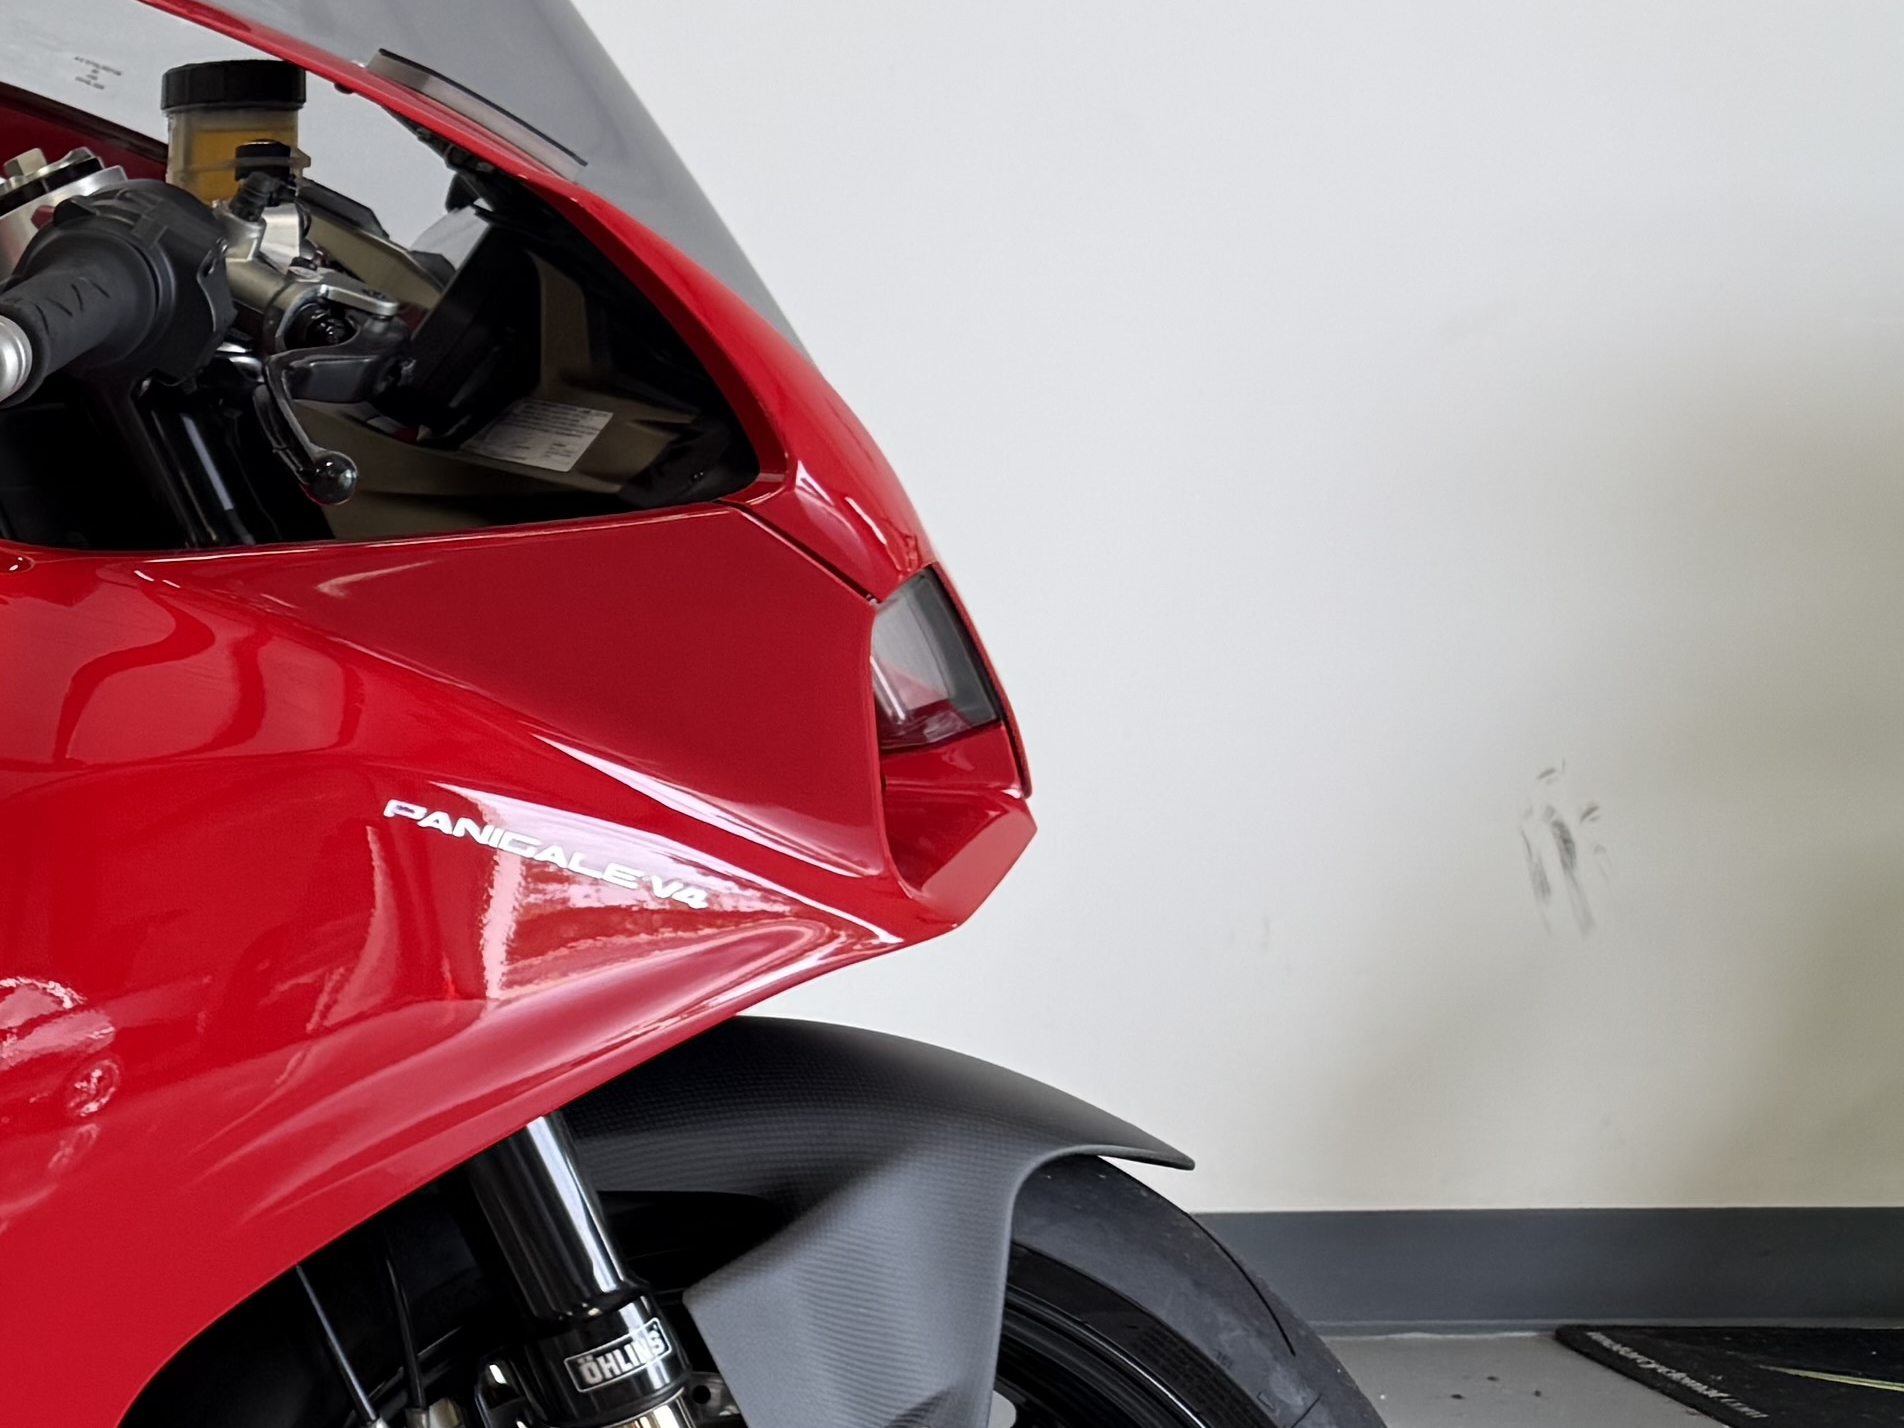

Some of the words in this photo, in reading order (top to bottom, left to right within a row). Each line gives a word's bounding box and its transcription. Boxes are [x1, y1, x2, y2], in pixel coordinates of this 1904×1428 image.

[383, 798, 640, 887] PANIGALE
[644, 872, 708, 910] V4
[580, 1328, 665, 1387] ÖHLINS
